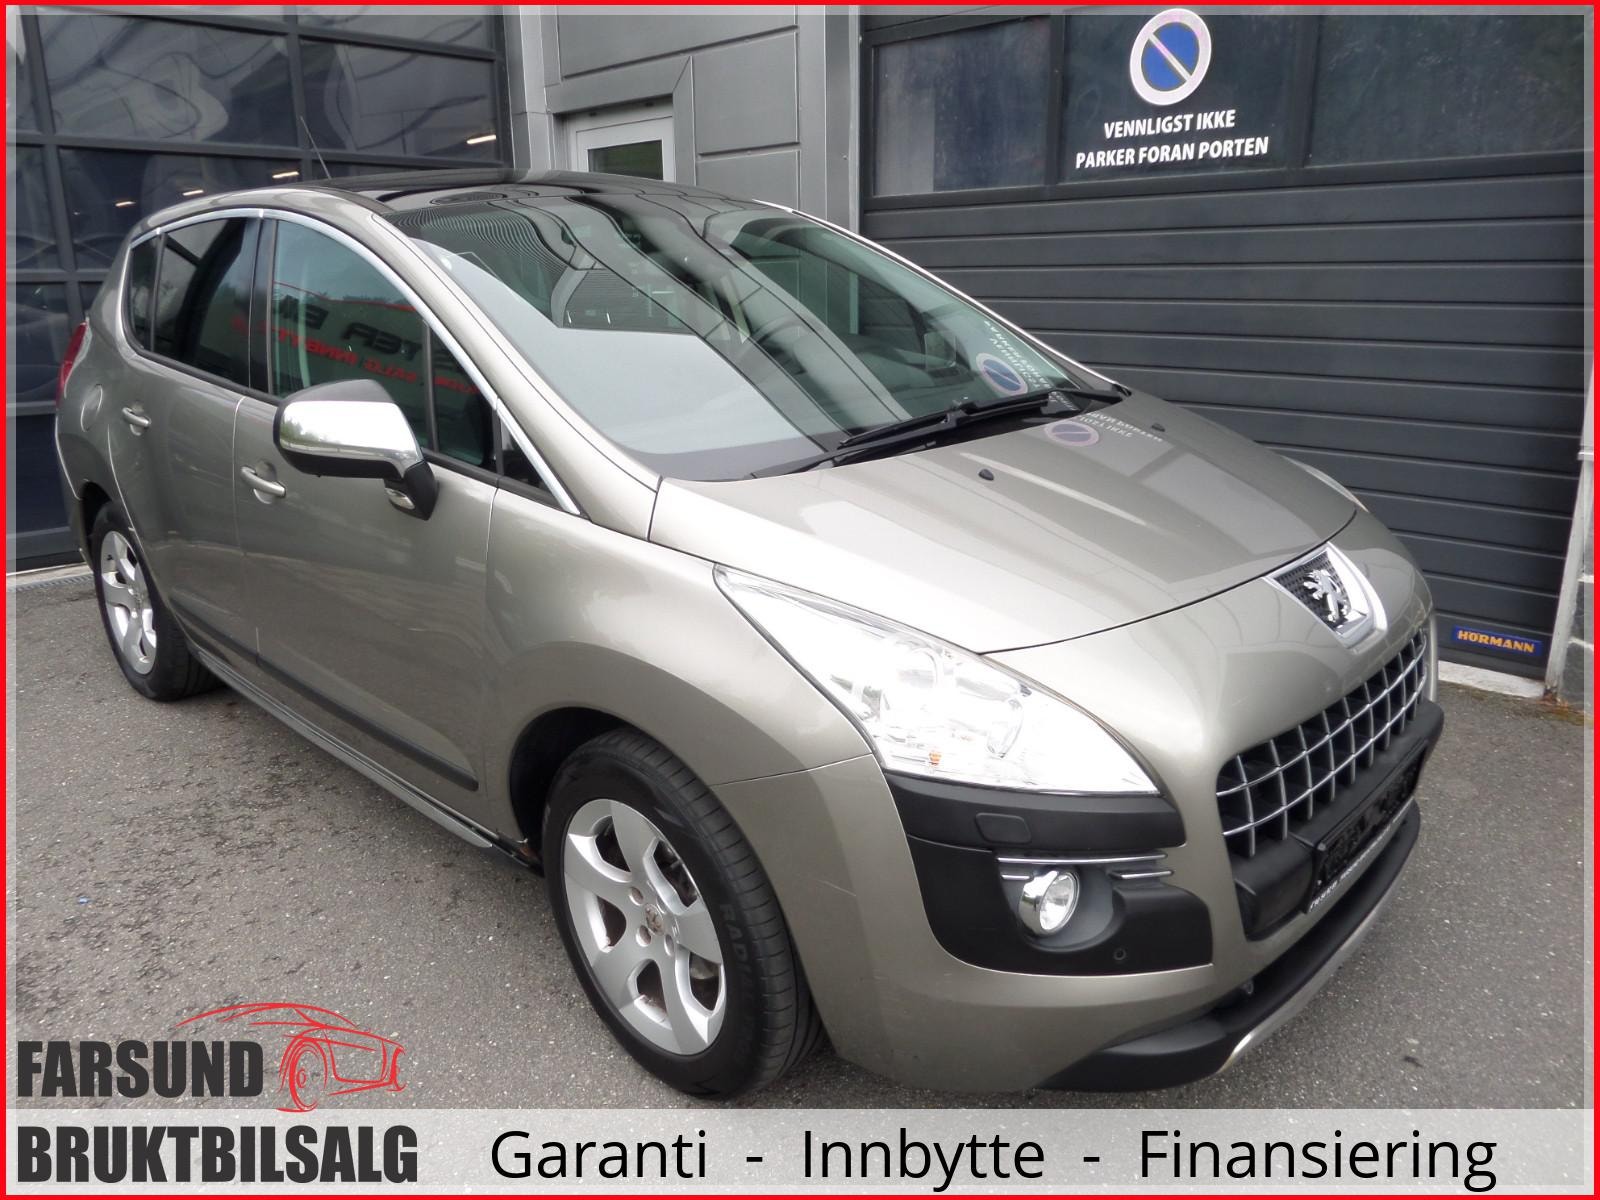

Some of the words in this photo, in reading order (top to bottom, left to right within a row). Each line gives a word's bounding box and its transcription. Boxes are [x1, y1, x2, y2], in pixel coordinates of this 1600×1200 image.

[1104, 114, 1193, 139] VENNLIGST
[1196, 109, 1236, 131] IKKE
[1075, 148, 1136, 169] PARKER
[1137, 143, 1195, 164] FORAN
[1197, 136, 1269, 160] PORTEN
